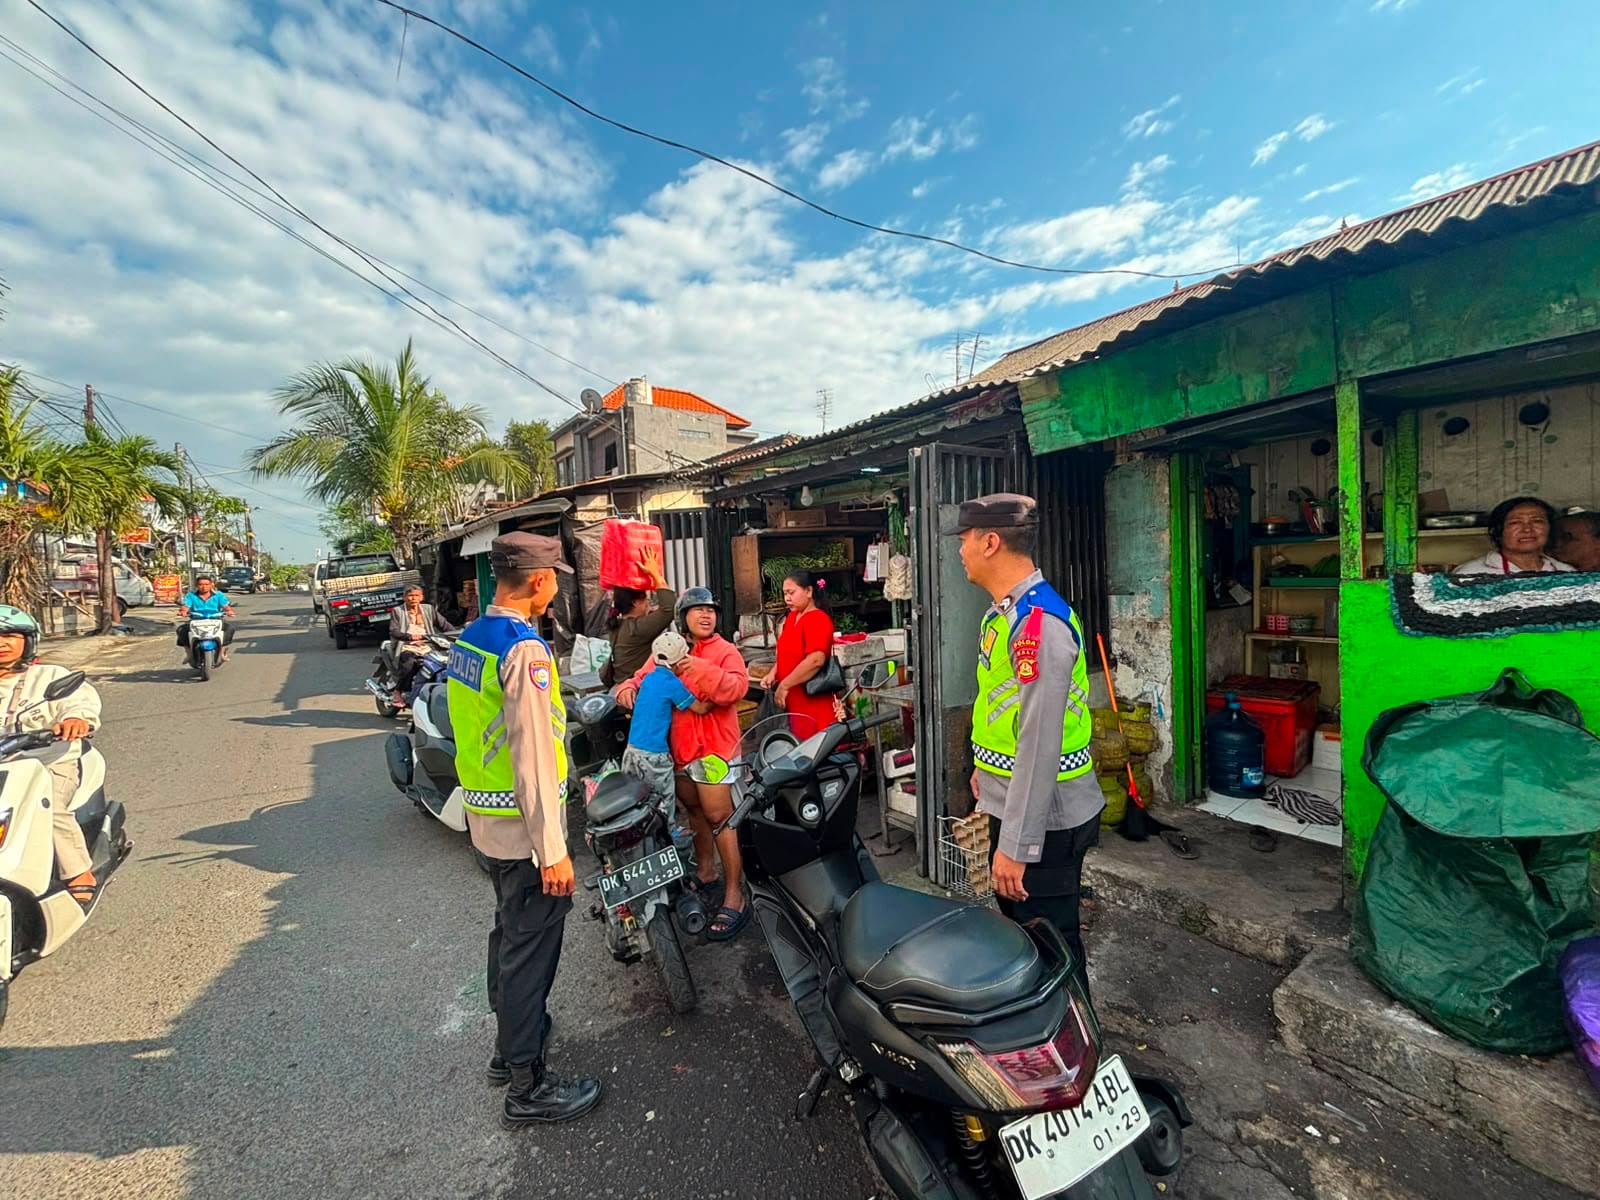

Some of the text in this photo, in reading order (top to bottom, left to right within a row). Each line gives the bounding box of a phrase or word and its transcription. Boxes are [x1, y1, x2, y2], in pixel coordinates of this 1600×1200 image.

[448, 648, 481, 685] POLISI
[602, 848, 676, 892] DK 6441 DE
[1004, 1124, 1042, 1164] DK
[1092, 1068, 1130, 1113] ABL
